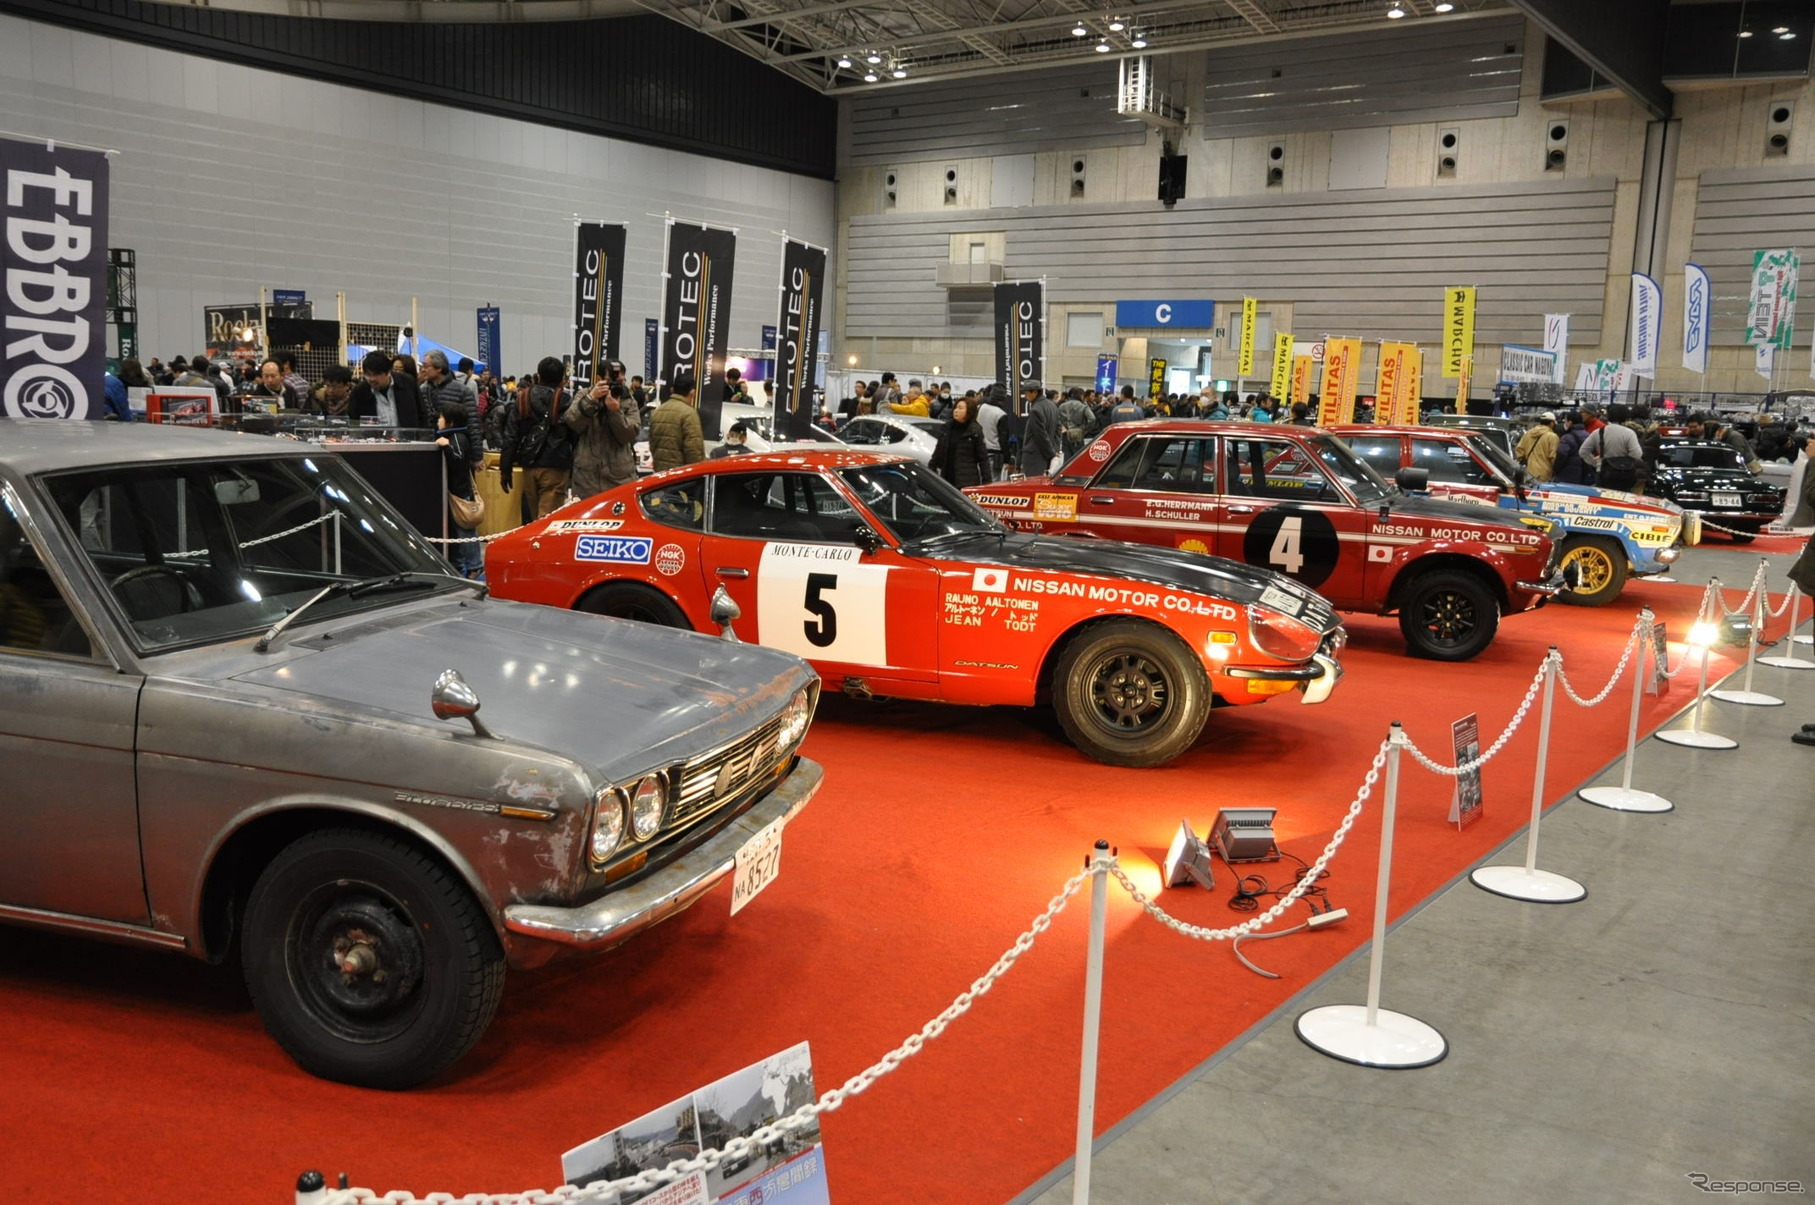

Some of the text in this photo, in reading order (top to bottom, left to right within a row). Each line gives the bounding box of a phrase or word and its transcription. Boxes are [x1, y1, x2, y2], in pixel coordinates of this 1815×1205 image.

[577, 249, 599, 386] ROTEC
[673, 251, 701, 380] ROTEC
[1155, 303, 1172, 323] C
[703, 348, 713, 386] Works
[1275, 347, 1288, 397] MARCHA
[1322, 355, 1341, 425] TILITAS
[979, 495, 1028, 506] DUNLOP
[1372, 524, 1424, 537] NISSAN
[1430, 528, 1481, 541] MOTOR
[1573, 516, 1614, 529] Castrol
[577, 538, 649, 560] SEIKO
[660, 550, 680, 560] NGK
[772, 545, 853, 561] MONTE-CARLO
[1269, 516, 1304, 574] 4
[945, 592, 1039, 611] RAUNO AALTONEN
[1013, 577, 1086, 598] NISSAN
[1088, 585, 1159, 608] MOTOR
[803, 572, 838, 648] 5
[945, 614, 1037, 632] JEAN TODT
[747, 843, 780, 896] 8527
